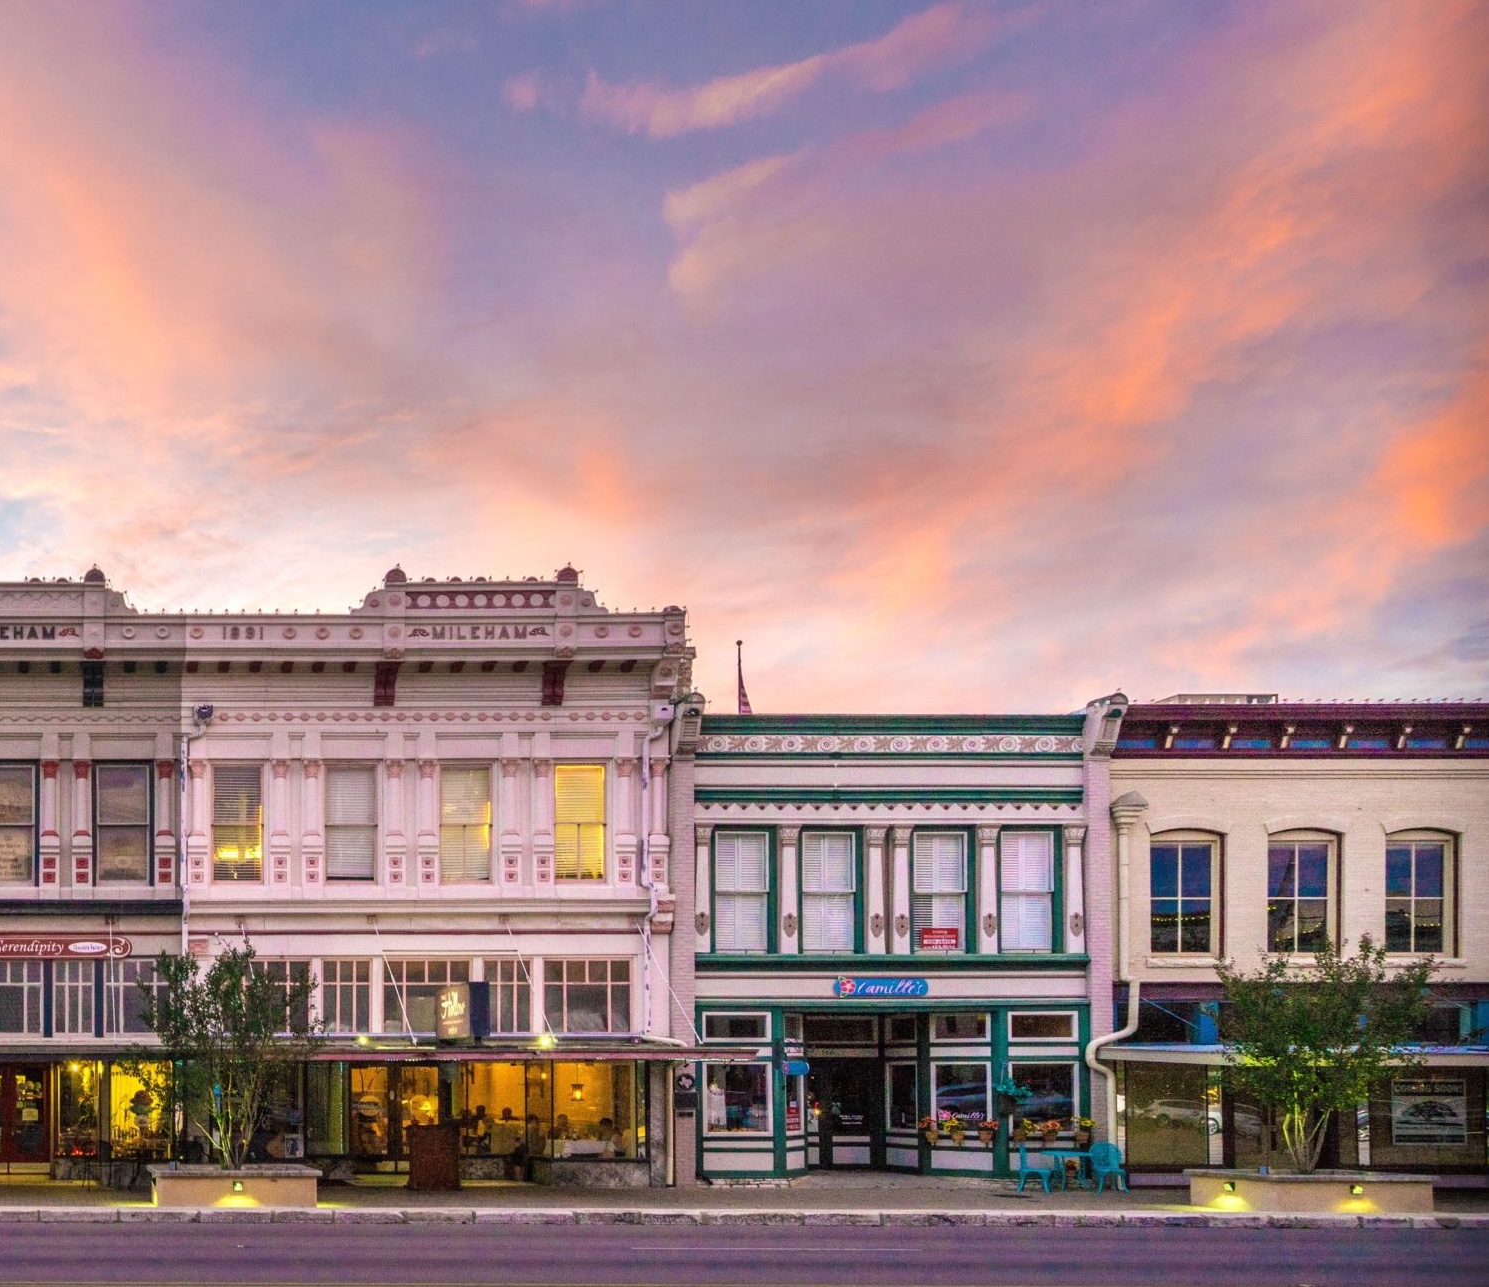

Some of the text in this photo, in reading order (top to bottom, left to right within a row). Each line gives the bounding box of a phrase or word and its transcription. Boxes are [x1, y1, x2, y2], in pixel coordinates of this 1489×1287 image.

[222, 625, 264, 640] 1891
[432, 625, 528, 640] MILEHAM
[857, 979, 923, 995] Camille's
